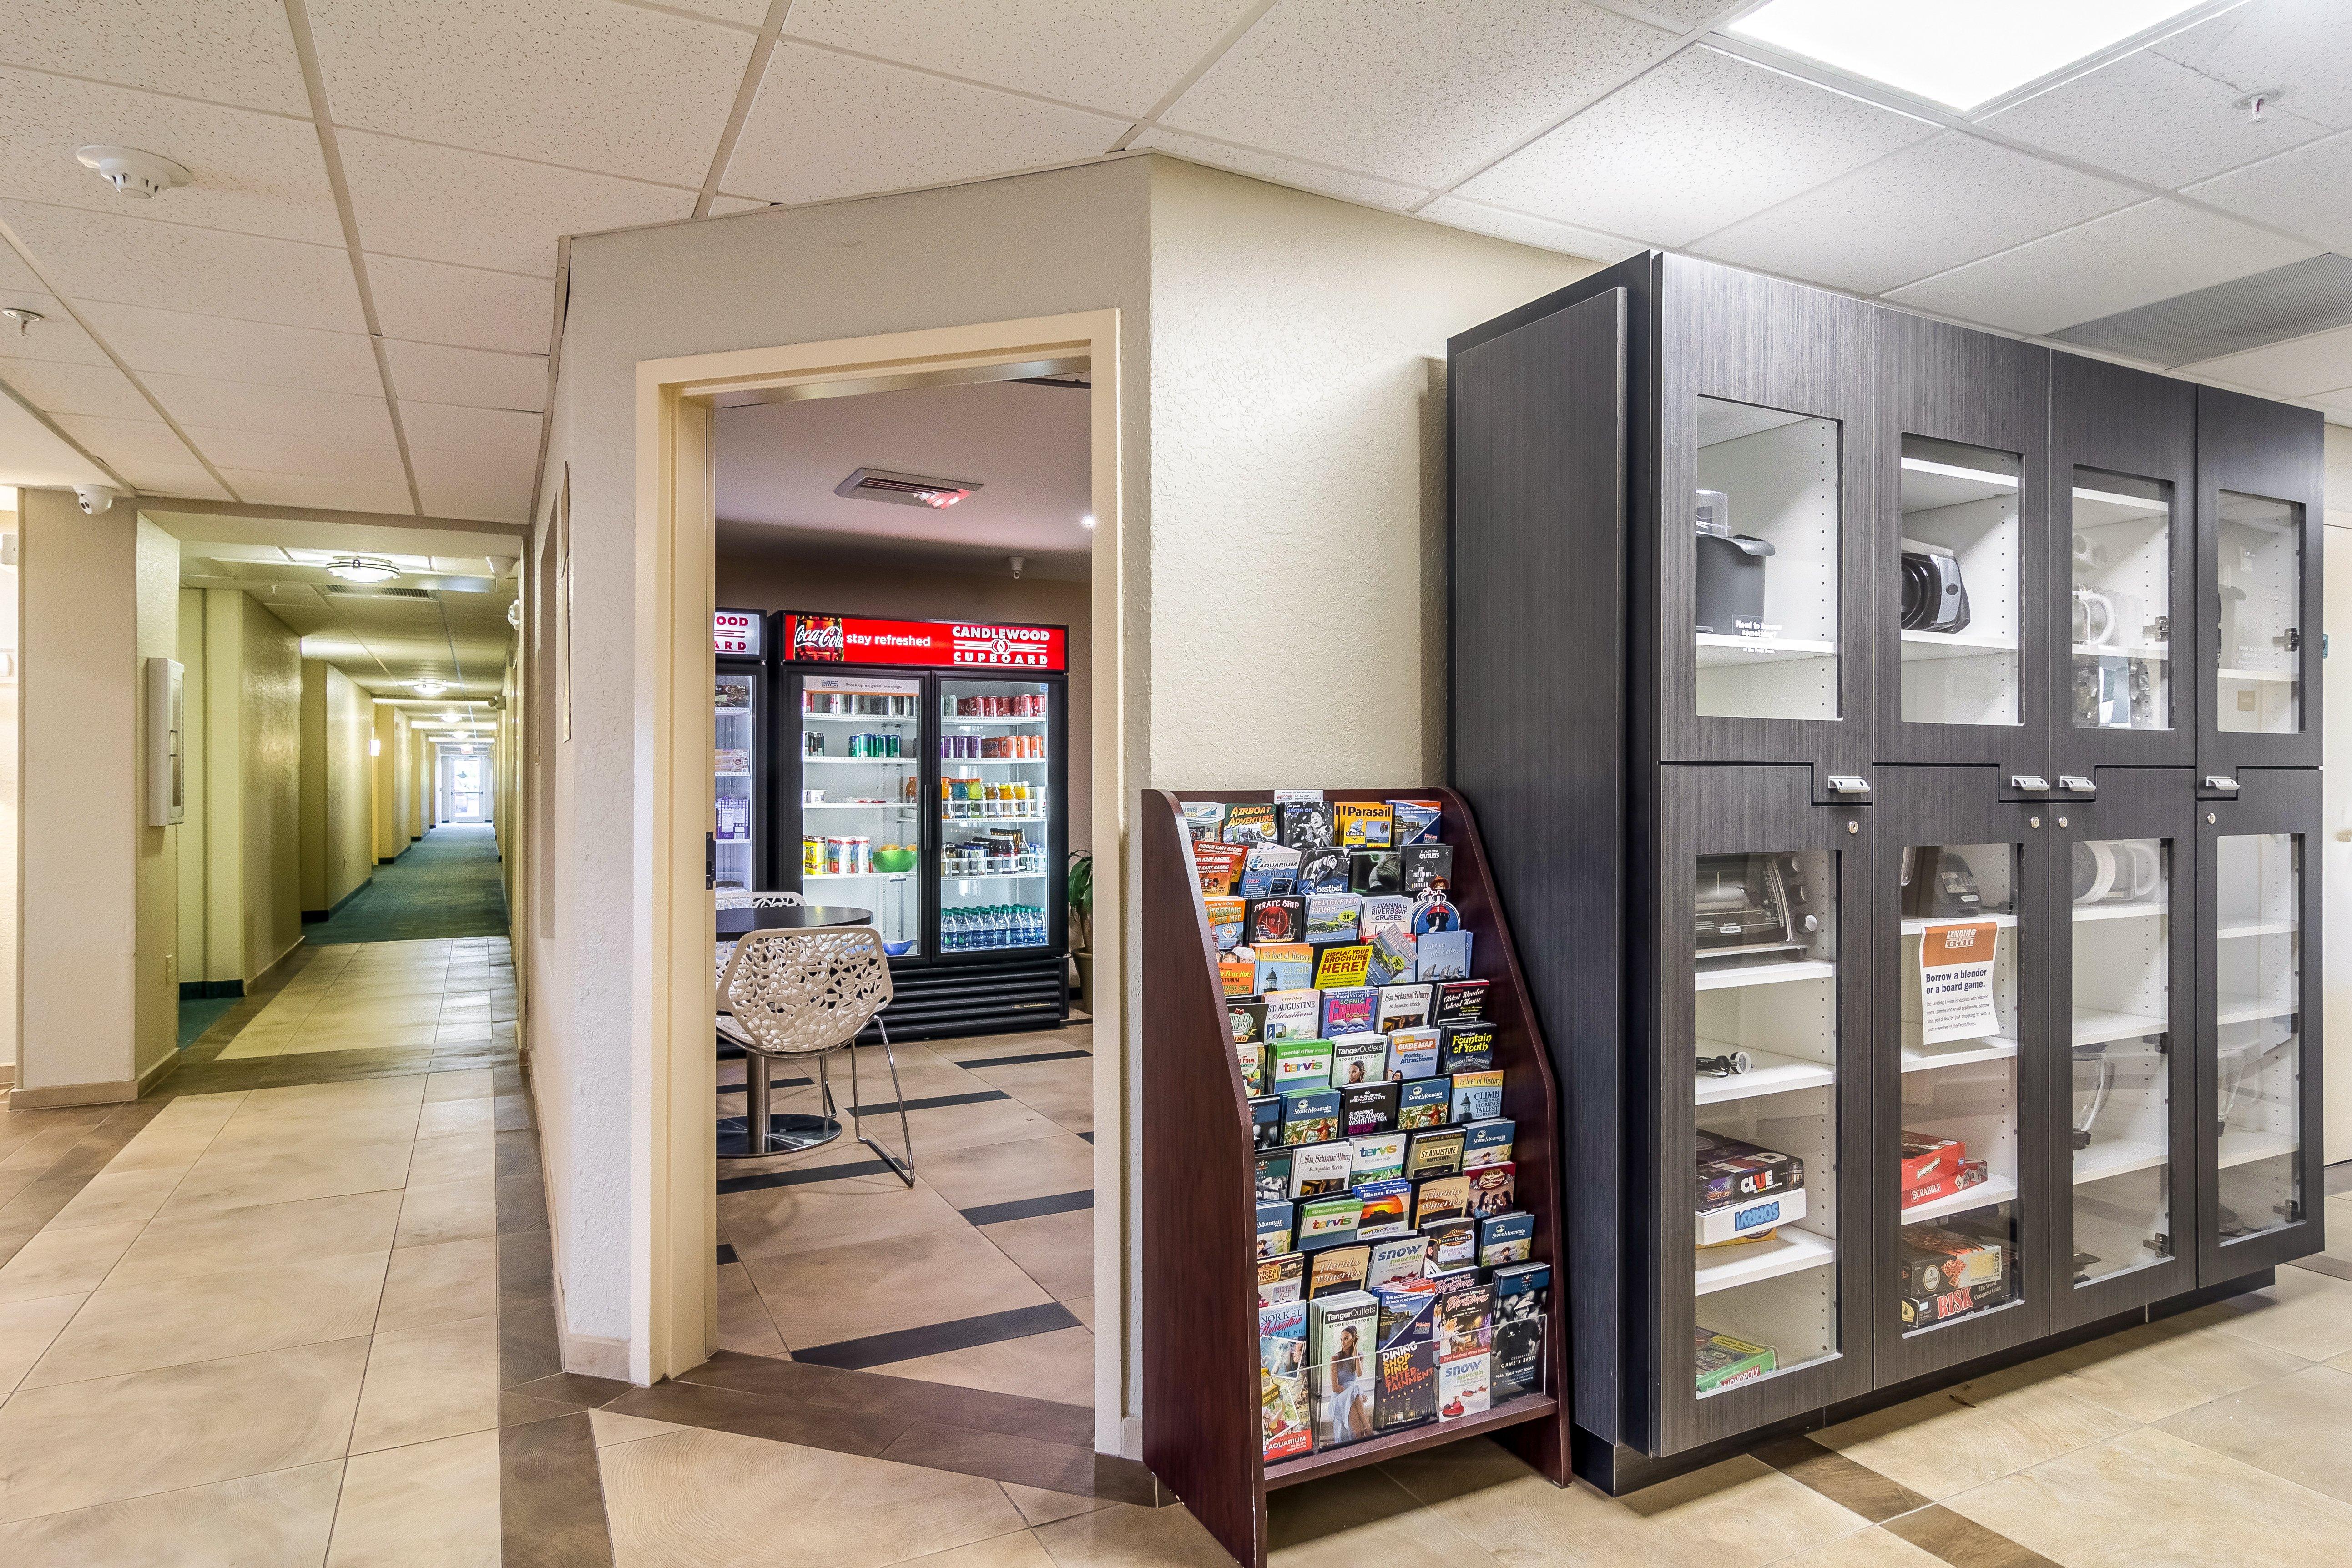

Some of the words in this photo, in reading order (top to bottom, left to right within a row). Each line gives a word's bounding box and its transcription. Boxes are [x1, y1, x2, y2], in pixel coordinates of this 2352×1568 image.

[794, 625, 843, 648] Coca-Cola
[952, 626, 1050, 641] CANDLEWOOD
[847, 634, 872, 646] stay
[875, 635, 931, 647] refreshed
[954, 652, 1048, 665] CUPBOARD
[1230, 806, 1272, 818] AIRBOAT
[1348, 807, 1391, 817] Parasail
[1228, 815, 1274, 829] ADVENTURE
[1316, 884, 1343, 892] bestbet
[1254, 900, 1281, 912] PIRATE
[1282, 900, 1300, 909] SHIP
[1312, 897, 1358, 907] HELICOPTER
[1947, 928, 1977, 938] LENDING
[1384, 931, 1400, 951] TOURS
[1390, 925, 1417, 962] HELICOPTER
[1424, 942, 1436, 950] Like
[1945, 939, 1974, 947] LOCKER
[1272, 950, 1282, 959] feet
[1284, 951, 1290, 960] of
[1292, 950, 1311, 962] History
[1324, 954, 1368, 963] BROCHURE
[1430, 951, 1445, 959] place
[1321, 960, 1367, 974] HERE!
[1926, 973, 1952, 983] Borrow
[1960, 968, 1987, 979] blender
[1942, 982, 1962, 992] board
[1964, 981, 1985, 991] game.
[1395, 991, 1413, 1001] Sebastian
[1414, 990, 1429, 999] Winery
[1444, 993, 1461, 1003] Oldest
[1463, 988, 1484, 998] Wooden
[1277, 1001, 1316, 1012] AUGUSTINE
[1328, 998, 1373, 1023] CRUISE
[1444, 1000, 1463, 1011] School
[1464, 998, 1481, 1006] House
[1269, 1010, 1313, 1020] Attractions
[1452, 1033, 1492, 1046] Fountain
[1398, 1042, 1418, 1051] GUIDE
[1453, 1044, 1463, 1054] of
[1464, 1042, 1488, 1053] Youth
[1400, 1056, 1433, 1064] Attractions
[1283, 1060, 1323, 1073] tervis
[1466, 1075, 1474, 1085] feet
[1477, 1075, 1482, 1084] of
[1484, 1074, 1501, 1085] History
[1474, 1090, 1500, 1100] CLIMB
[1360, 1143, 1397, 1157] tervis
[1429, 1146, 1456, 1155] AUGUSTINE
[1315, 1152, 1336, 1163] Sebastian
[1741, 1170, 1774, 1193] CLUE
[1424, 1186, 1462, 1201] Florida
[1912, 1183, 1941, 1200] SCRABBLE
[1421, 1199, 1463, 1211] Wineries
[1313, 1216, 1352, 1230] tervis
[1378, 1244, 1423, 1261] snow
[1320, 1257, 1361, 1273] Florida
[1390, 1254, 1422, 1264] mountain
[1315, 1269, 1362, 1283] Wineries
[1275, 1285, 1296, 1294] SISTER
[1986, 1281, 1997, 1289] World
[1974, 1289, 1991, 1301] Conquest
[1937, 1286, 1974, 1320] RISK
[1346, 1317, 1373, 1326] DIRECTORY
[1276, 1329, 1302, 1338] ZIPLINE
[1382, 1341, 1418, 1361] DINING
[1383, 1353, 1414, 1369] SHOP-
[1501, 1359, 1521, 1368] GAME'S
[1384, 1362, 1409, 1377] PING
[1445, 1360, 1482, 1377] snow
[1457, 1369, 1484, 1380] mountain
[1385, 1367, 1433, 1393] TAINMENT
[1268, 1436, 1306, 1450] AQUARIUM
